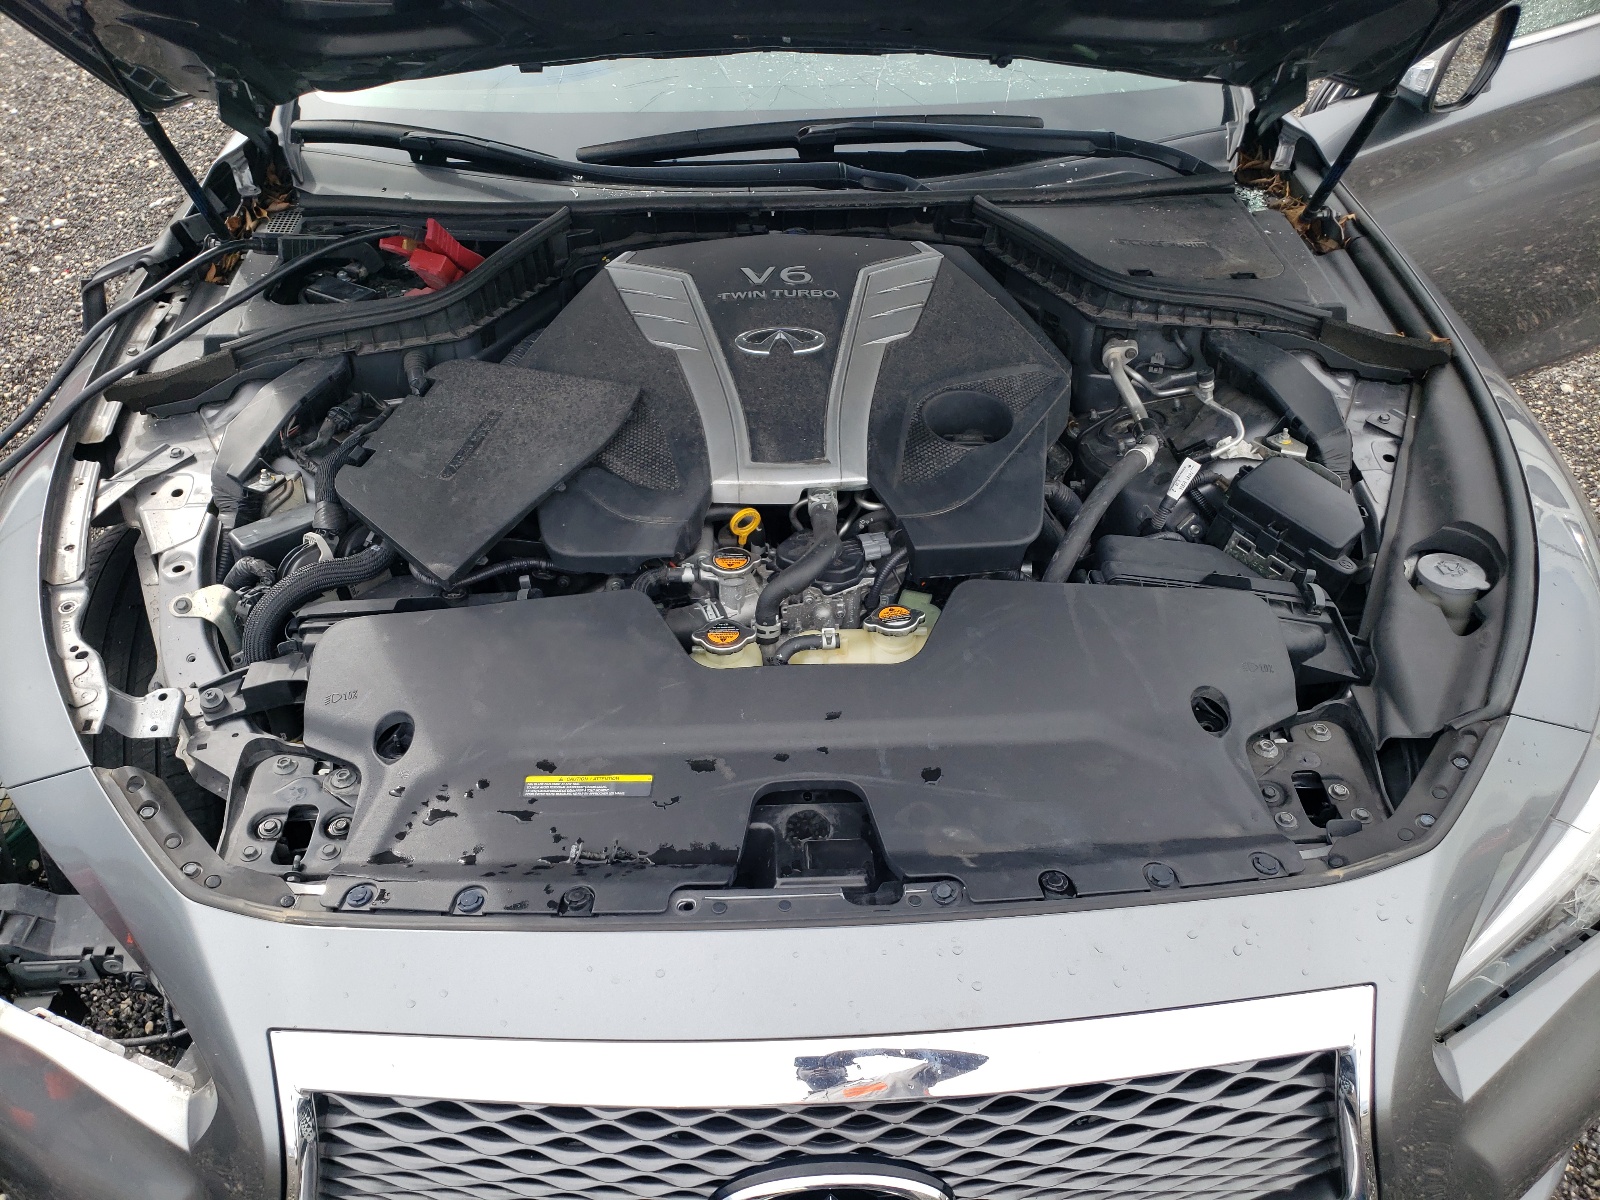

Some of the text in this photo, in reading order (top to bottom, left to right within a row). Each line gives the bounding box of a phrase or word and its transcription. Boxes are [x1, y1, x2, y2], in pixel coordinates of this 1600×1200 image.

[740, 265, 812, 285] V6
[720, 289, 838, 300] TWIN TURBO
